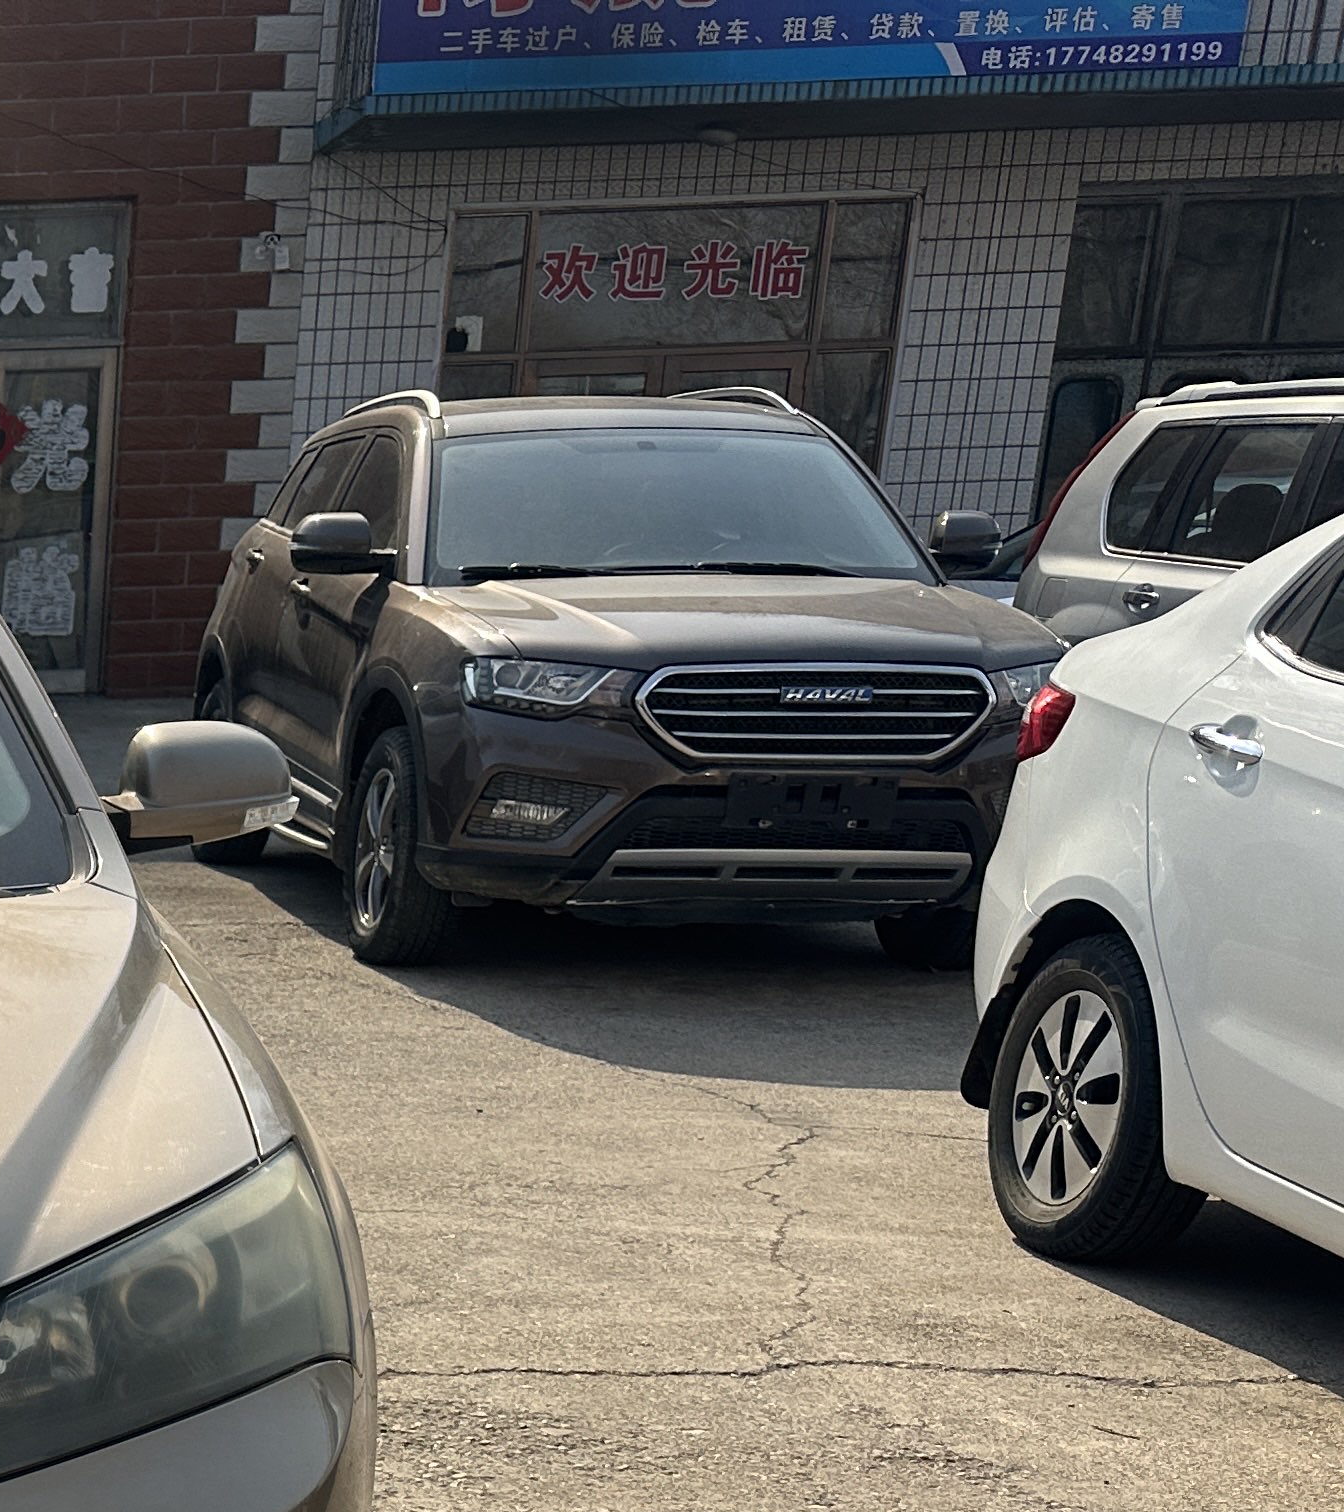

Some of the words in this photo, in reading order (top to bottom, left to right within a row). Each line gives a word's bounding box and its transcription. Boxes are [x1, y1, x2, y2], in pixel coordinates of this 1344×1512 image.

[439, 3, 1185, 54] 二手车过户、保险、检车、租赁、贷款、置换、评估、寄售
[540, 240, 810, 302] 欢迎光临
[785, 688, 871, 702] HAVAL
